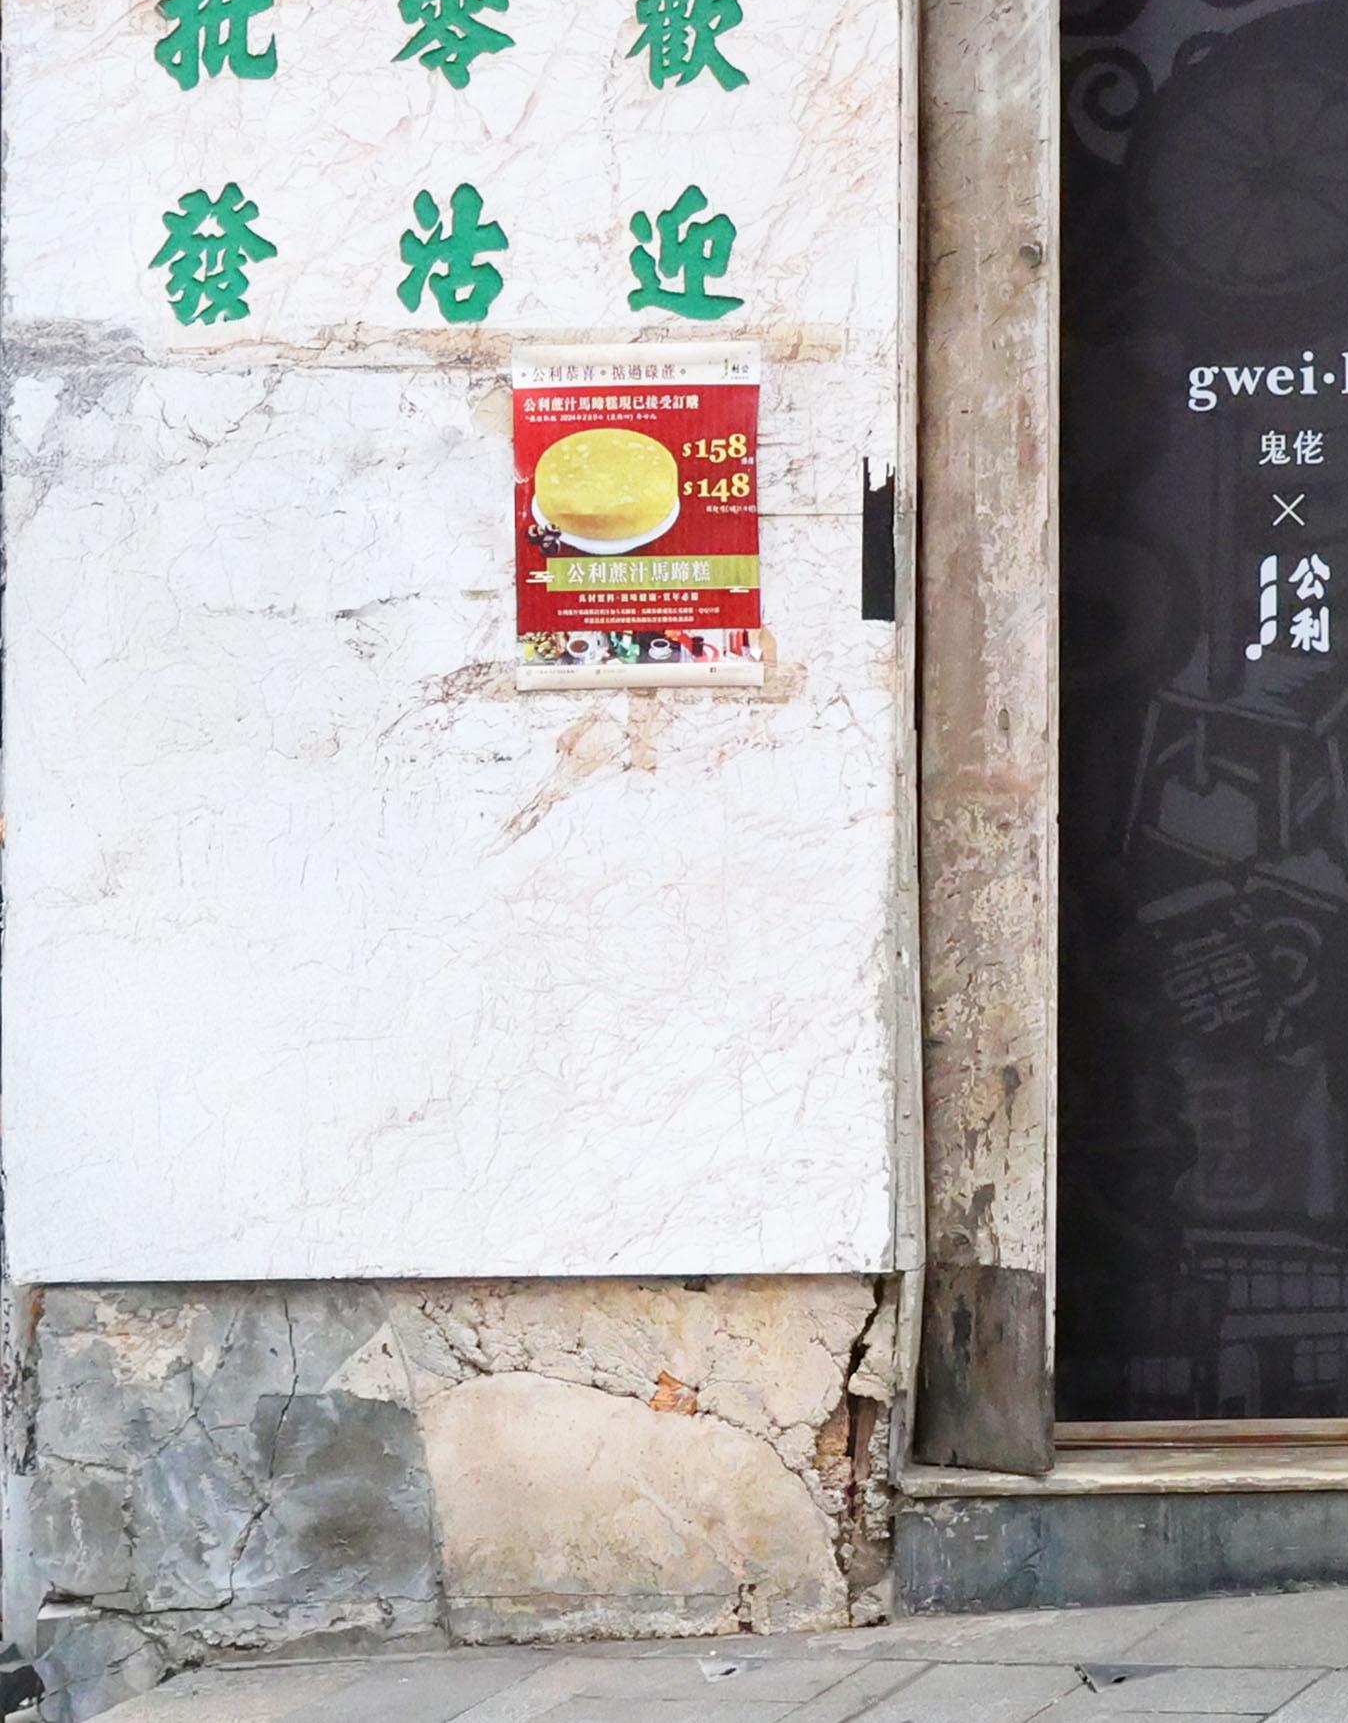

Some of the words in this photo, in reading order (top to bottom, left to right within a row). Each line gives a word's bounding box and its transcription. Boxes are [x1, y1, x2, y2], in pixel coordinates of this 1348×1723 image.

[682, 433, 747, 463] $158
[1259, 430, 1325, 465] 鬼佬
[683, 472, 751, 503] $148
[1288, 553, 1332, 653] 公利
